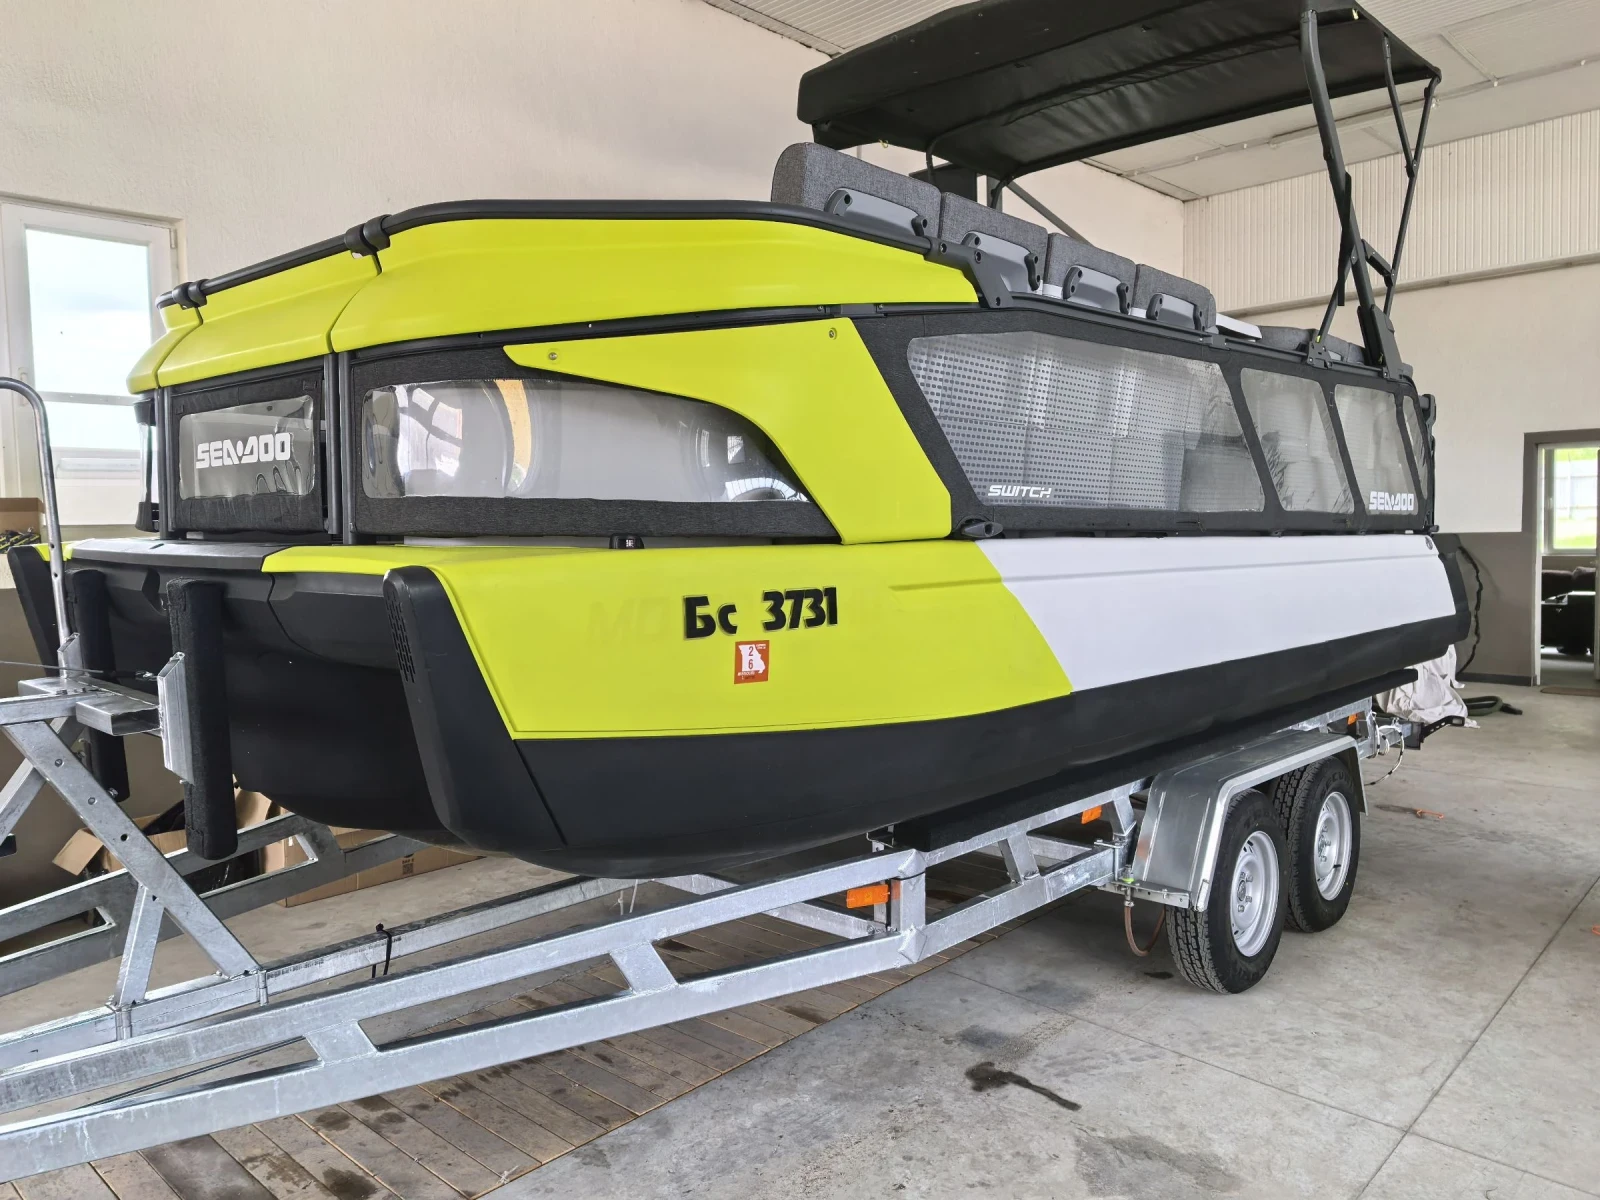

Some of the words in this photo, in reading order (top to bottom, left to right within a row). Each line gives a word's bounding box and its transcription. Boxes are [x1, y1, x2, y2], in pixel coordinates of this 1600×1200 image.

[987, 484, 1052, 498] SWITCH
[761, 586, 838, 632] 3731
[748, 646, 754, 657] 2
[748, 659, 754, 670] 6
